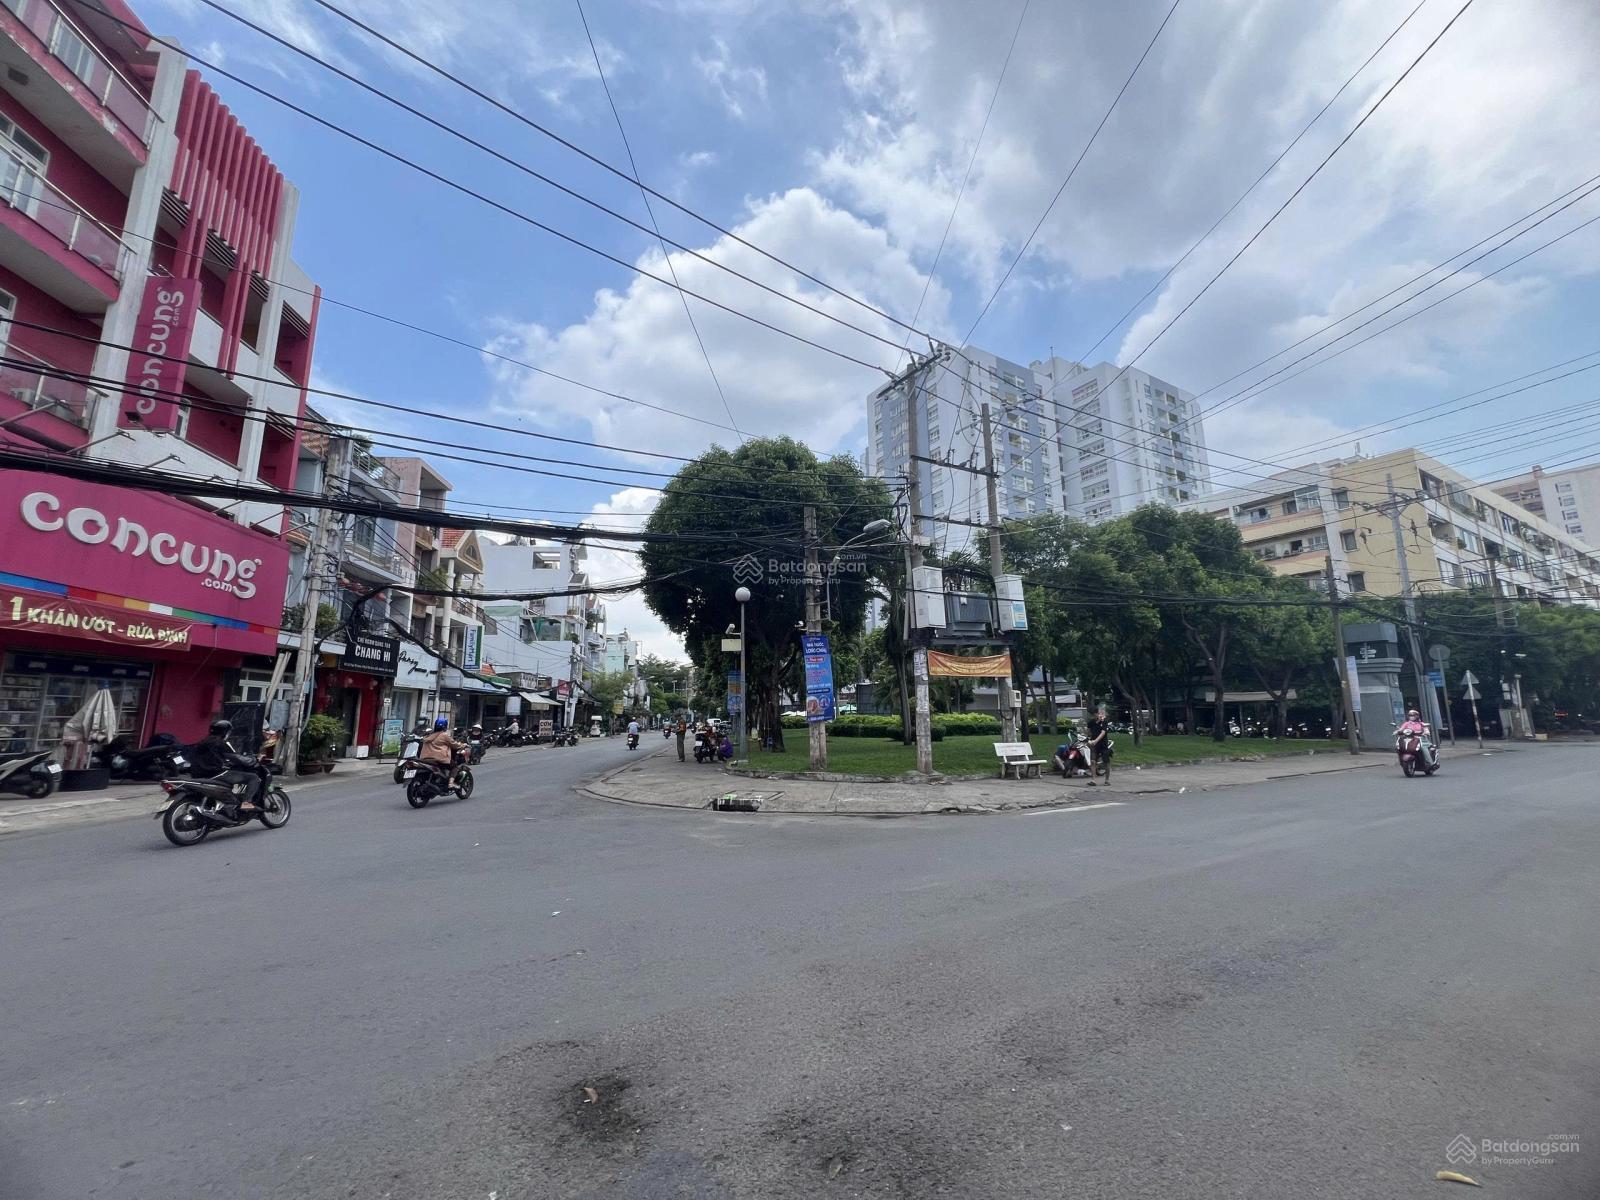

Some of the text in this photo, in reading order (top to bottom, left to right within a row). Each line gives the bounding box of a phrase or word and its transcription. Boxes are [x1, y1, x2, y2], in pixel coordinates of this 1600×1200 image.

[201, 577, 233, 593] .com
[10, 596, 24, 621] 1
[27, 608, 79, 628] KHĂN
[126, 622, 156, 641] RỬA
[355, 645, 381, 660] CHANG
